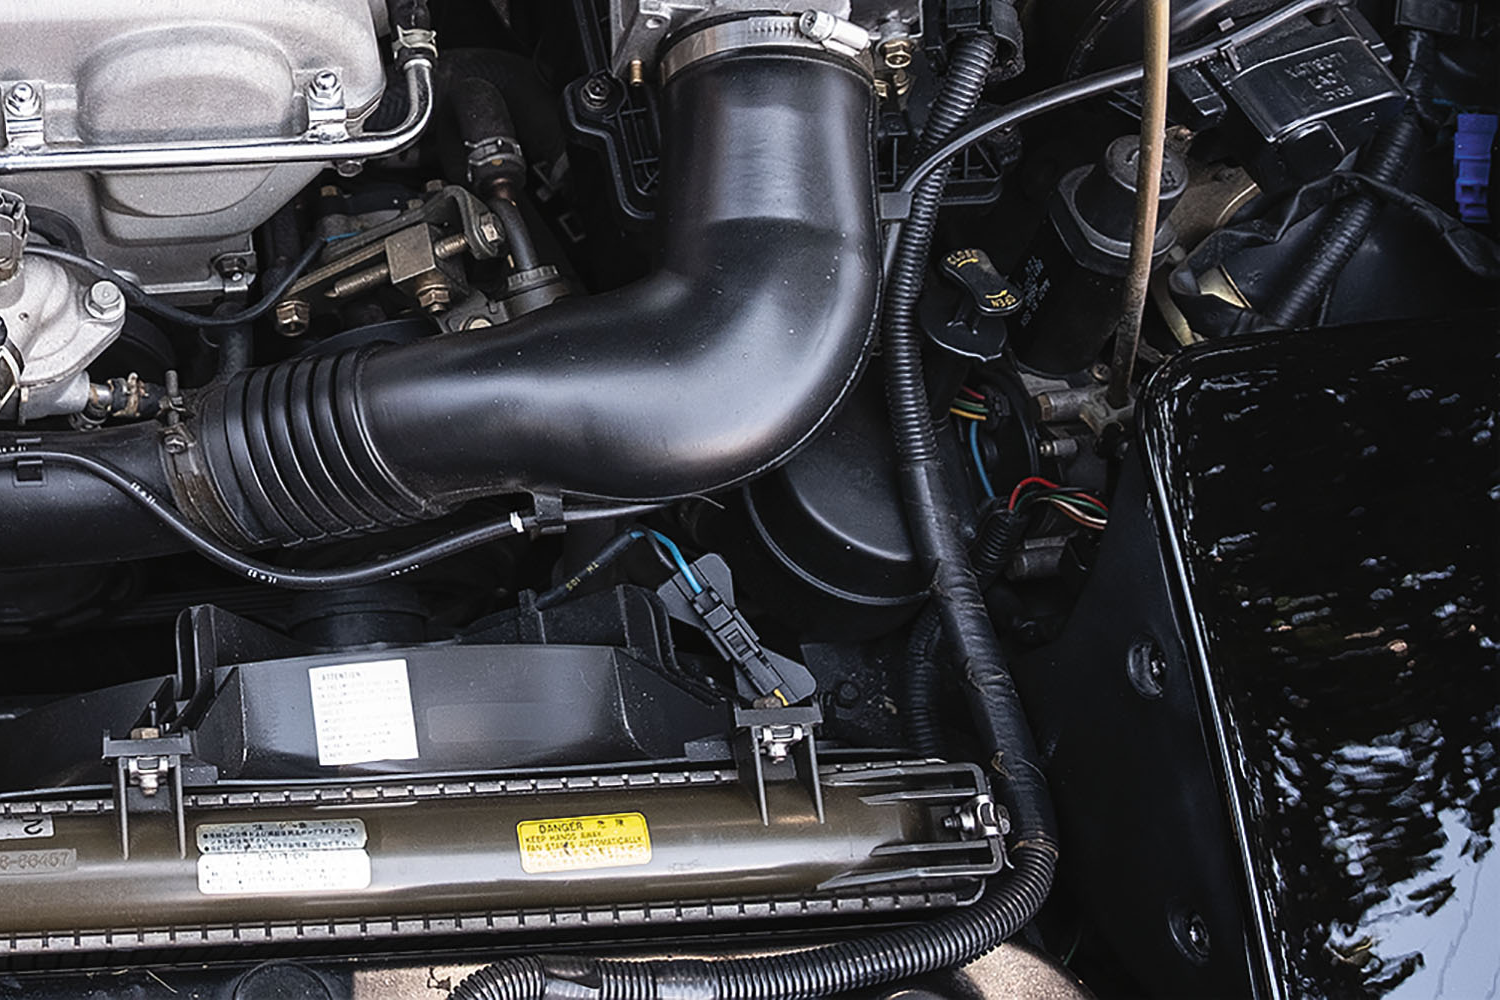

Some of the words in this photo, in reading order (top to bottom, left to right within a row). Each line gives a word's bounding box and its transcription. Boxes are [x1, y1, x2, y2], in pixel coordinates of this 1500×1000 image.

[23, 818, 44, 835] 2
[538, 820, 585, 835] DANGER
[579, 835, 642, 848] AUTOMATICALLY
